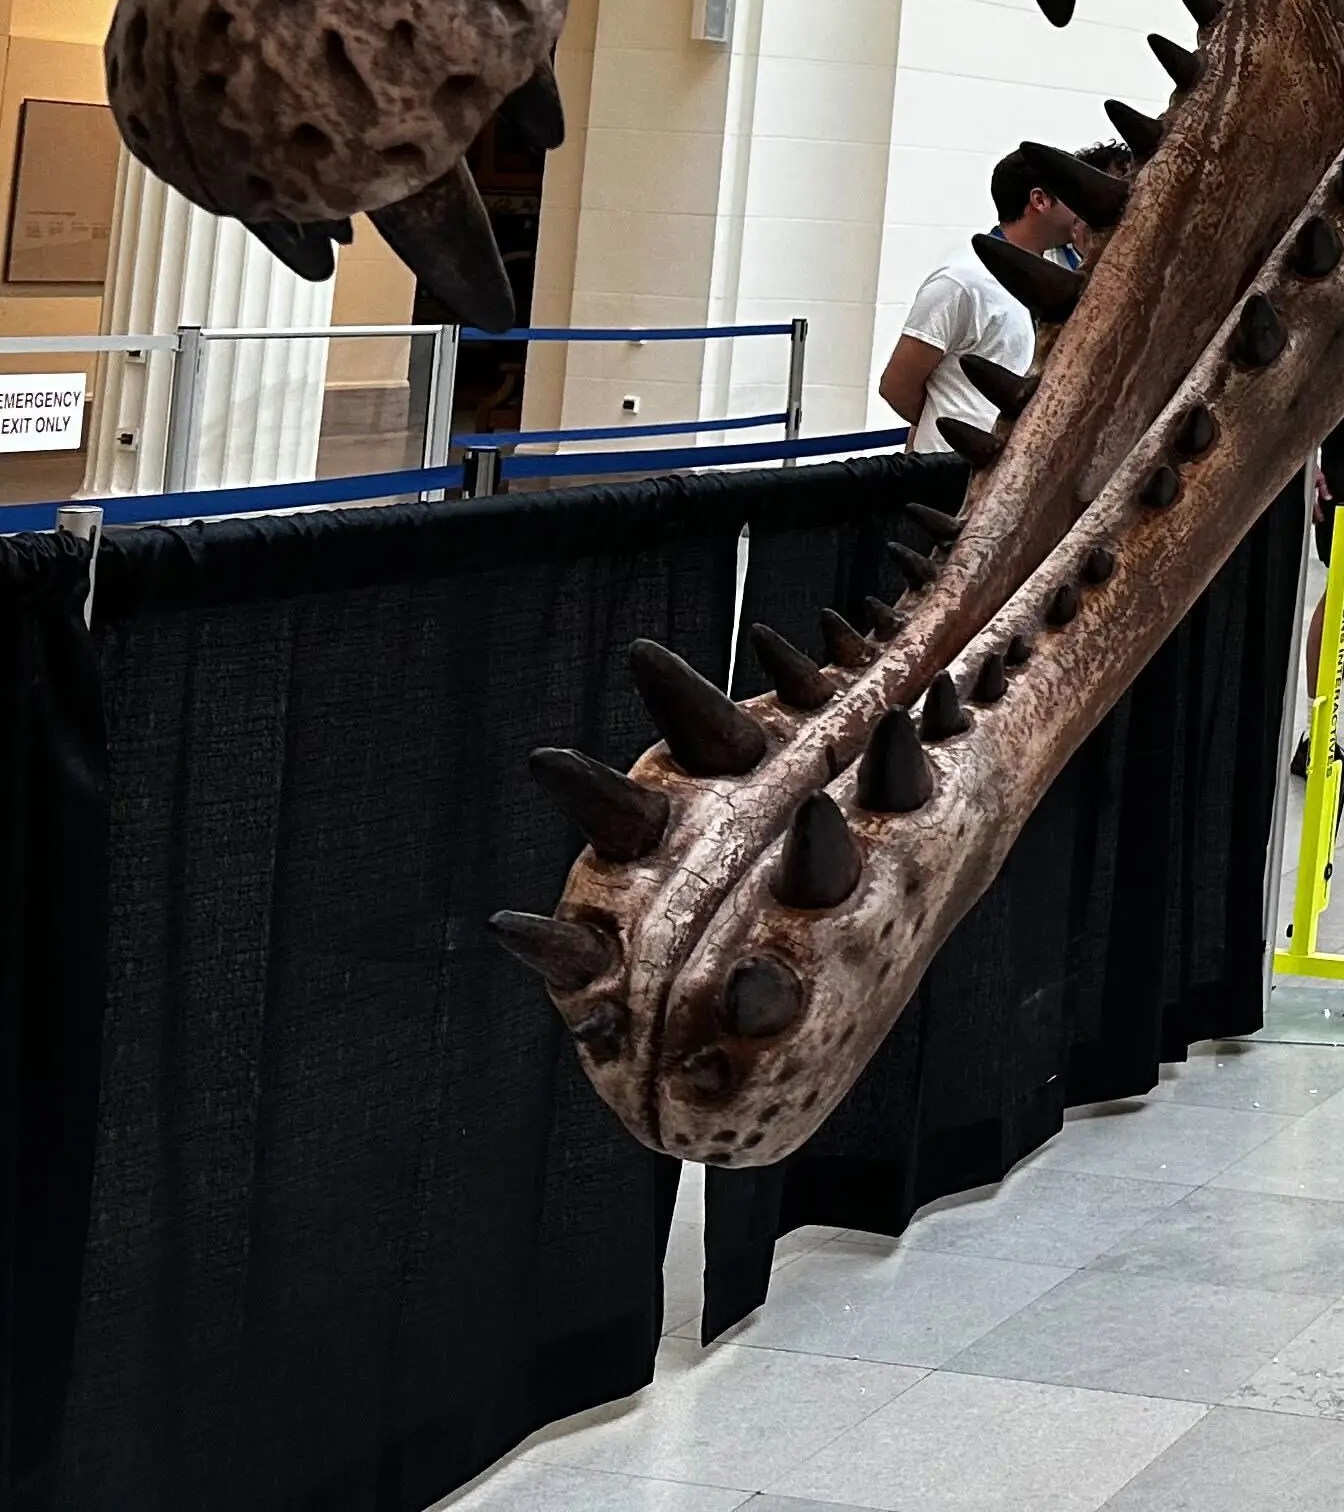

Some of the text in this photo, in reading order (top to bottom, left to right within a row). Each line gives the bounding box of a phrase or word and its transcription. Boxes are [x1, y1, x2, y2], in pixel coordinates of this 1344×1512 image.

[1, 416, 71, 434] EXIT ONLY
[1326, 648, 1344, 779] INTERACTIVES
